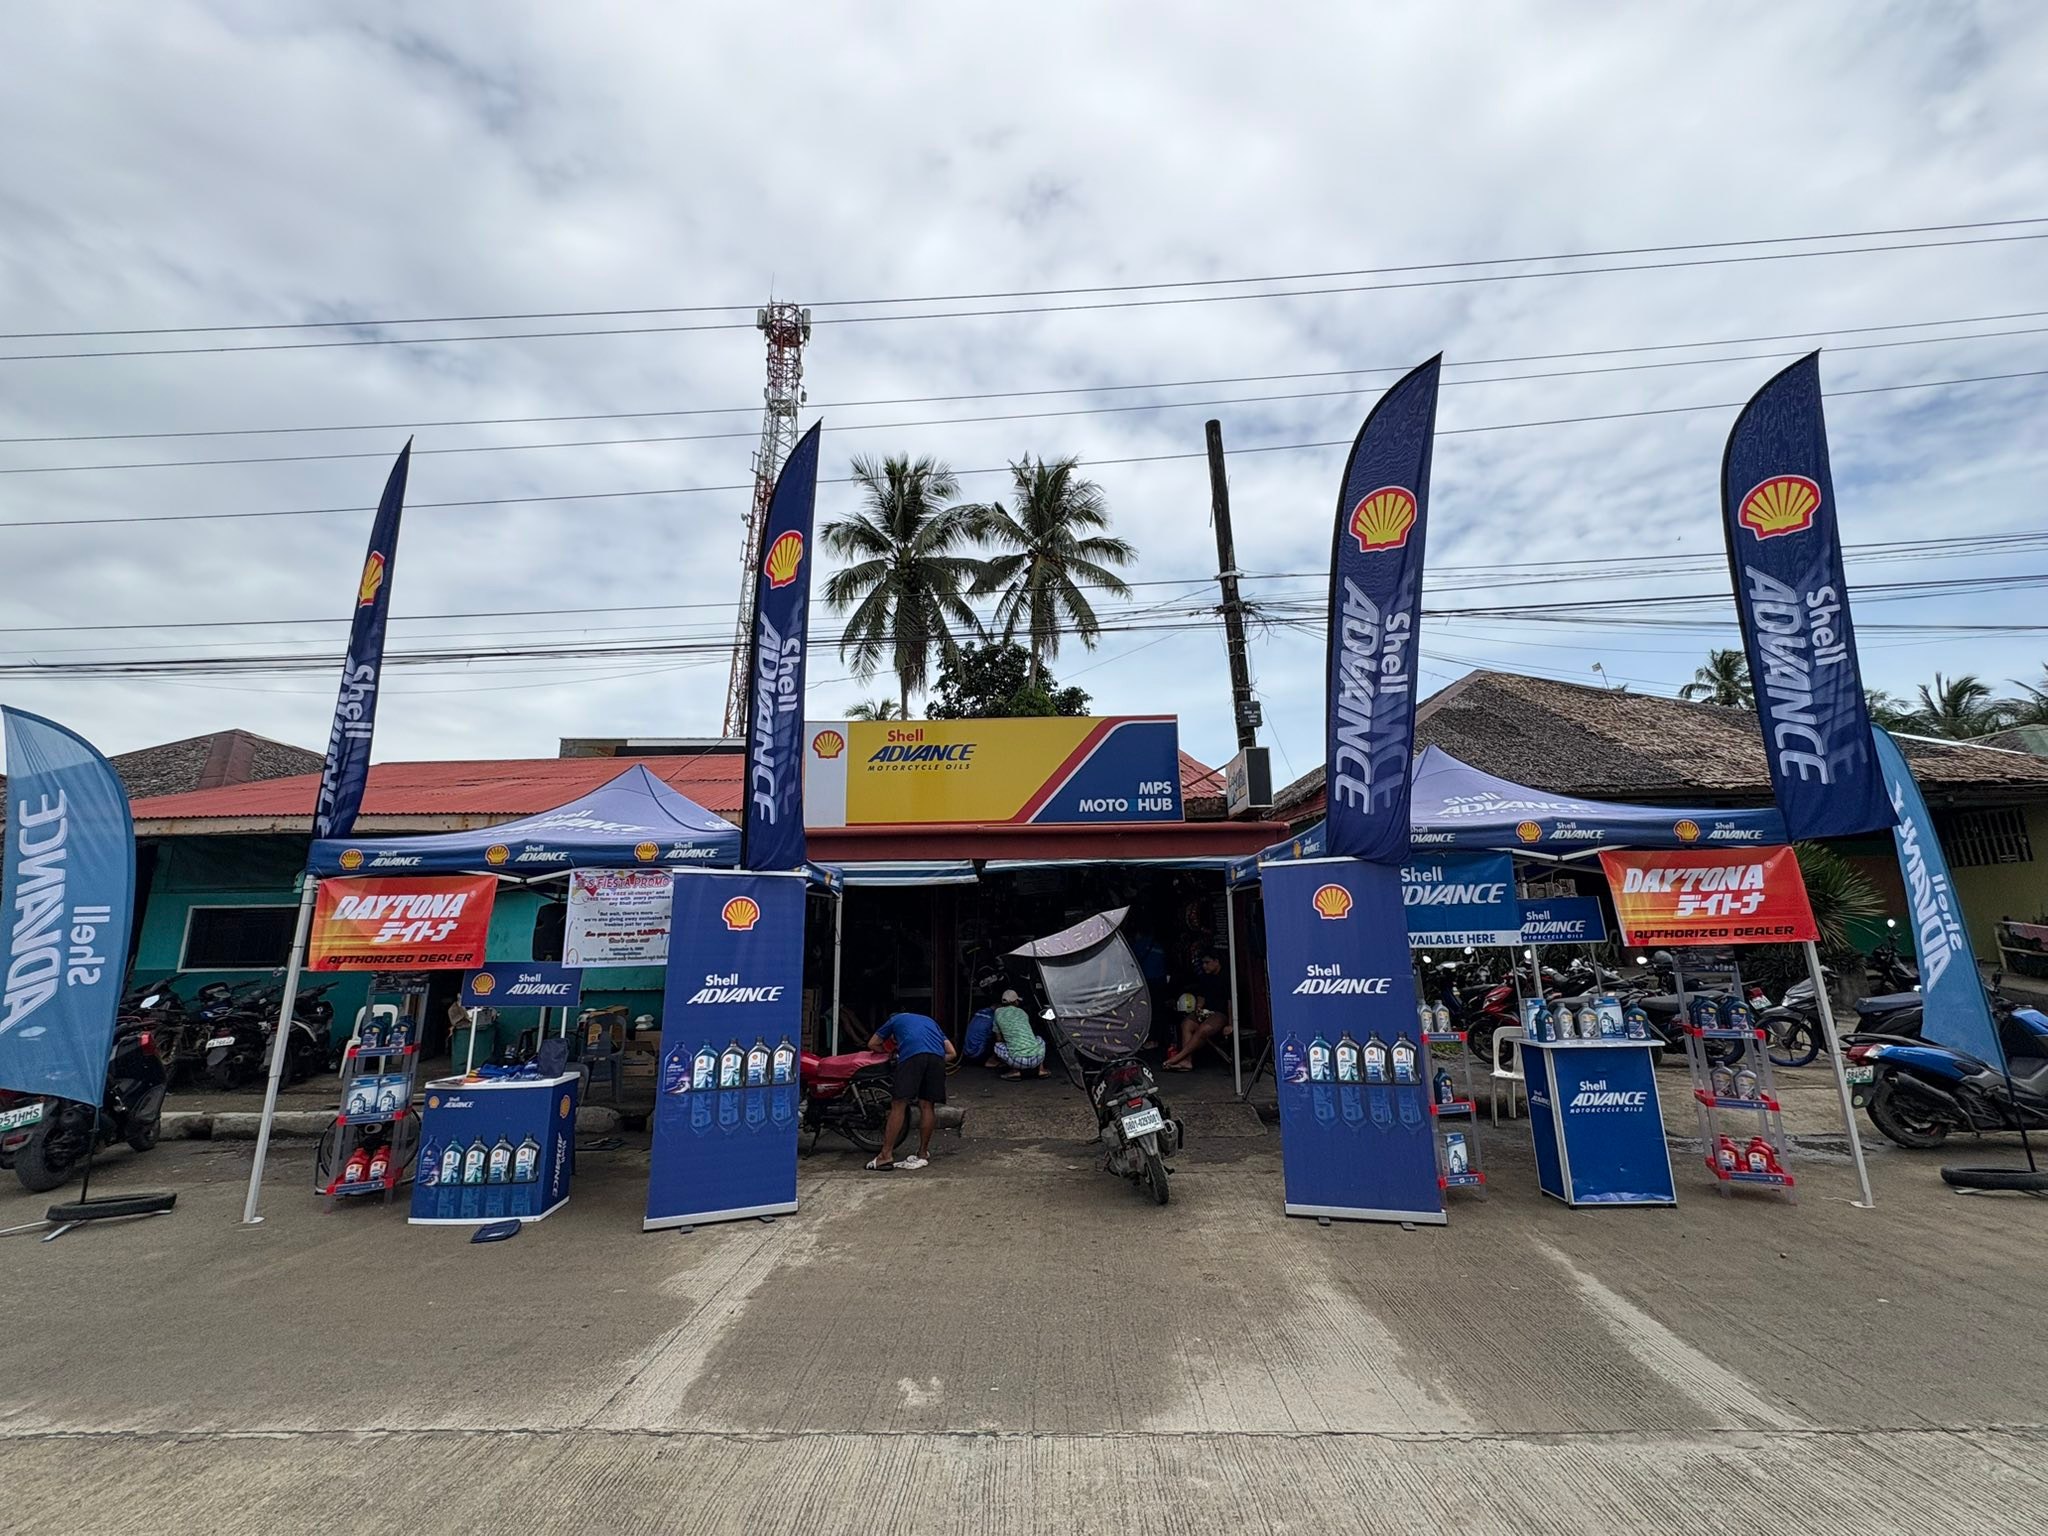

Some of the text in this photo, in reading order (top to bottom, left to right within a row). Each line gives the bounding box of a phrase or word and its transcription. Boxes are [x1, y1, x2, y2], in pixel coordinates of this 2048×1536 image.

[1806, 585, 1847, 667] Shell
[1380, 611, 1410, 694] Shell
[777, 637, 801, 712] Shell
[1745, 564, 1829, 785] ADVANCE
[345, 664, 376, 739] Shell
[1337, 575, 1380, 815] ADVANCE
[751, 611, 782, 826] ADVANCE
[887, 728, 924, 742] Shell
[867, 743, 978, 763] ADVANCE
[867, 763, 940, 772] MOTORCYCLE
[1138, 781, 1172, 795] MPS
[1079, 798, 1173, 813] MOTO HUB
[1556, 821, 1577, 830] Shell
[1715, 822, 1735, 830] Shell
[1411, 833, 1456, 843] DVANCE
[1550, 829, 1606, 840] ADVANCE
[1707, 830, 1764, 840] ADVANCE
[525, 845, 545, 853] Shell
[664, 848, 719, 860] ADVANCE
[368, 856, 422, 868] ADVANCE
[515, 851, 569, 863] ADVANCE
[1400, 866, 1443, 883] Shell
[1623, 864, 1764, 893] DAYTONA
[1402, 883, 1507, 906] DVANCE
[331, 893, 468, 921] DAYTONA
[1526, 911, 1551, 921] Shell
[1520, 920, 1586, 934] ADVANCE
[1634, 926, 1795, 939] AUTHORIZED DEALER
[1408, 933, 1496, 946] VAILABLE HERE
[327, 953, 474, 965] AUTHORIZED DEALER
[1306, 964, 1341, 976] Shell
[519, 974, 542, 982] Shell
[705, 973, 739, 986] Shell
[505, 984, 572, 995] ADVANCE
[1292, 978, 1392, 994] ADVANCE
[686, 986, 784, 1005] ADVANCE
[1579, 1080, 1606, 1091] Shell
[1570, 1092, 1648, 1107] ADVANCE
